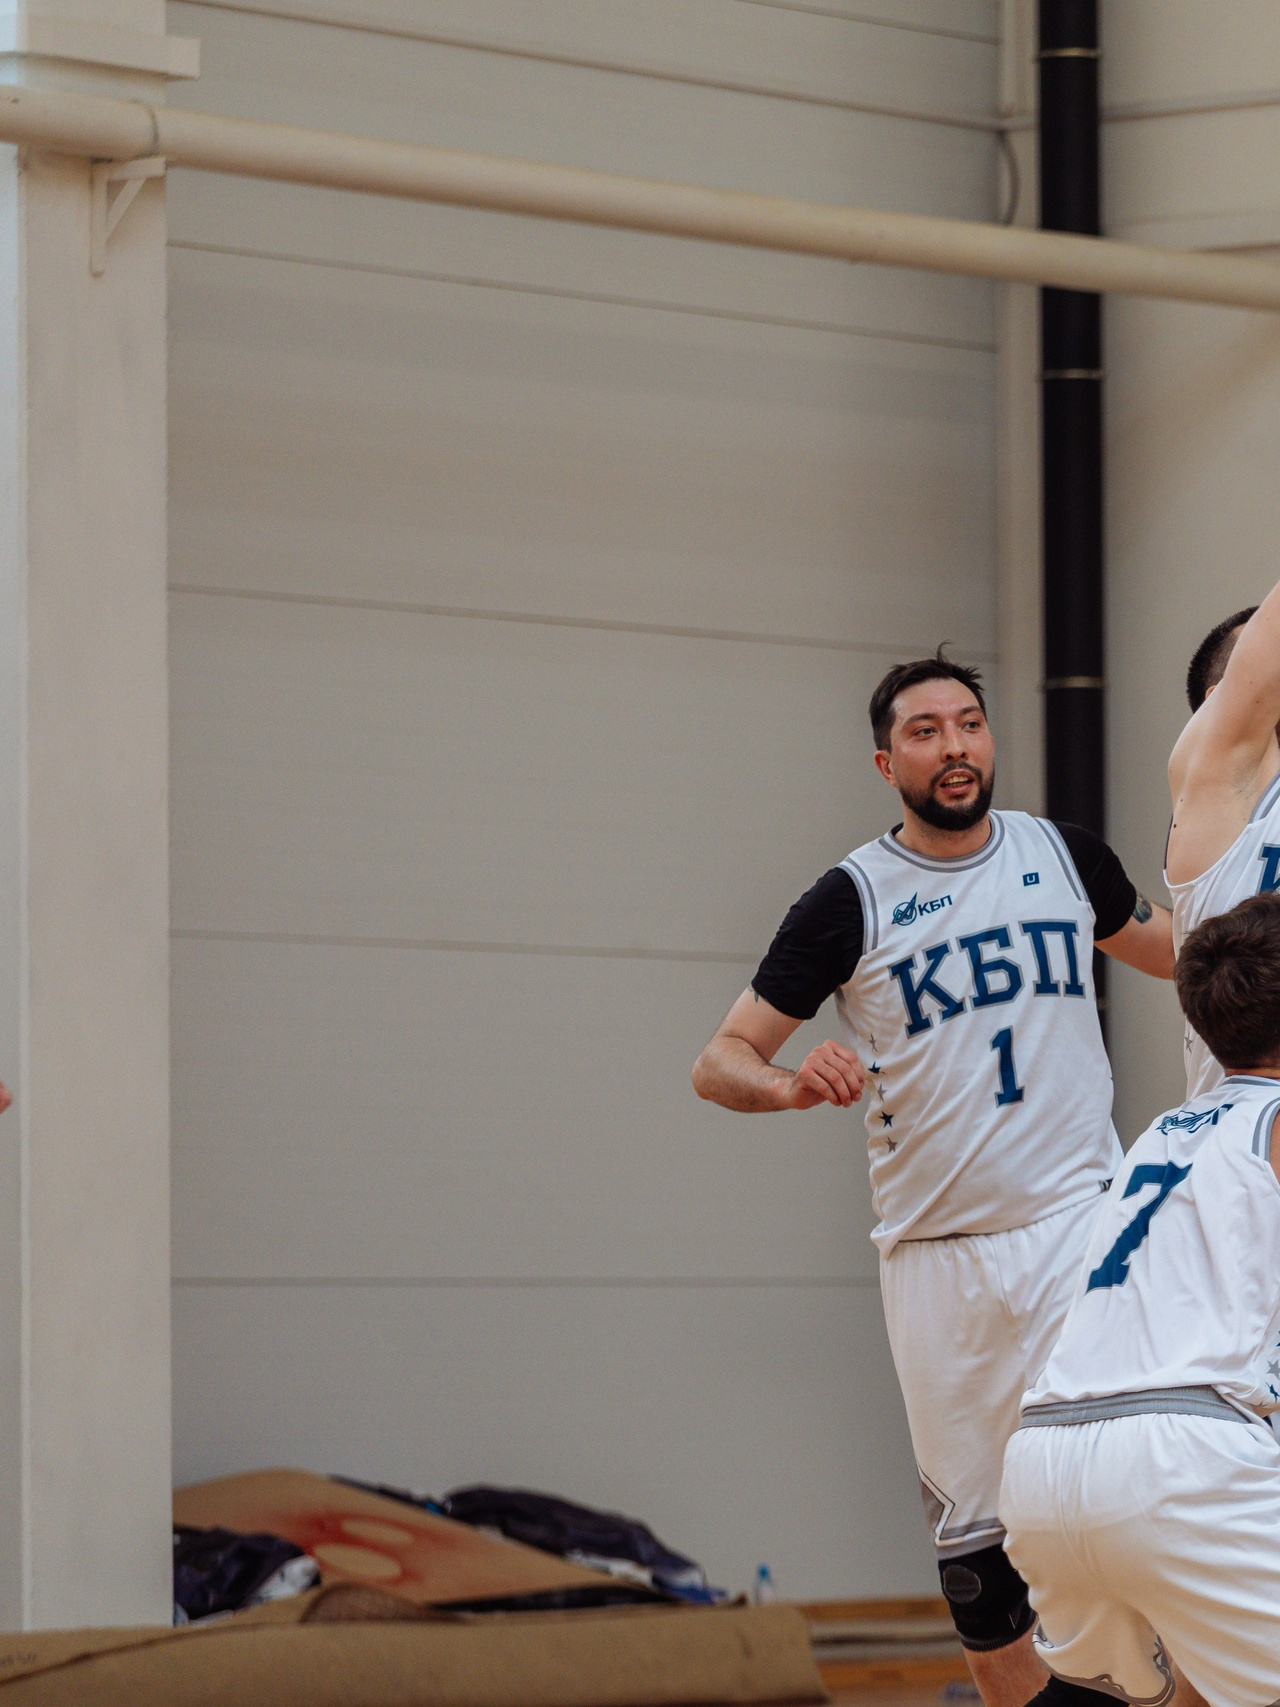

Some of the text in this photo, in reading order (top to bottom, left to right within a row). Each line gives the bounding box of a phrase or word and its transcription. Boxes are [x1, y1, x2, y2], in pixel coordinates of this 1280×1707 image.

[918, 895, 953, 916] КБП
[887, 919, 1087, 1039] КБП
[989, 1026, 1025, 1109] 1
[1084, 1161, 1194, 1297] 7
